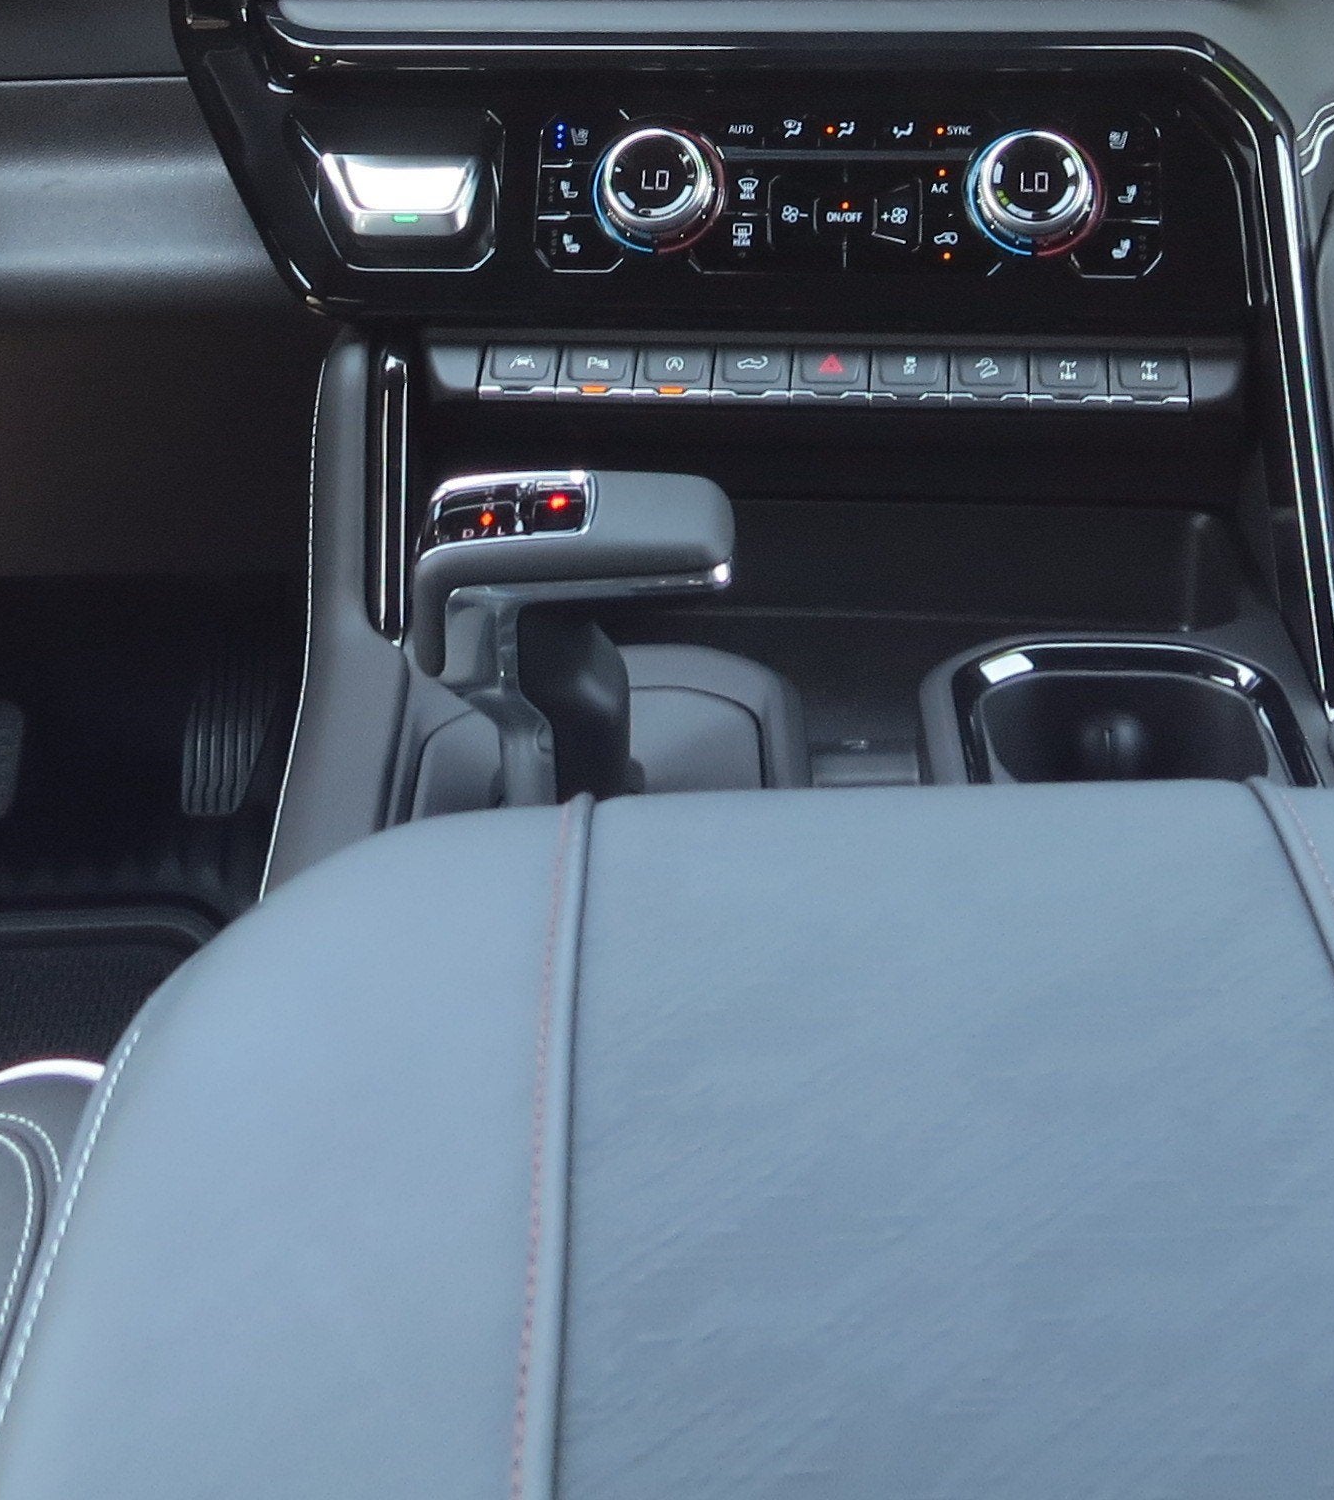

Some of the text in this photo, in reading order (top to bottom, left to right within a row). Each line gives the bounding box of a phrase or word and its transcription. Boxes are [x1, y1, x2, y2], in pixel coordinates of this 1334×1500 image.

[729, 124, 753, 134] AUTO
[947, 126, 971, 136] SYNC
[641, 170, 669, 190] LO
[1021, 172, 1049, 192] LO
[931, 184, 949, 194] A/C
[827, 212, 862, 222] ON/OFF
